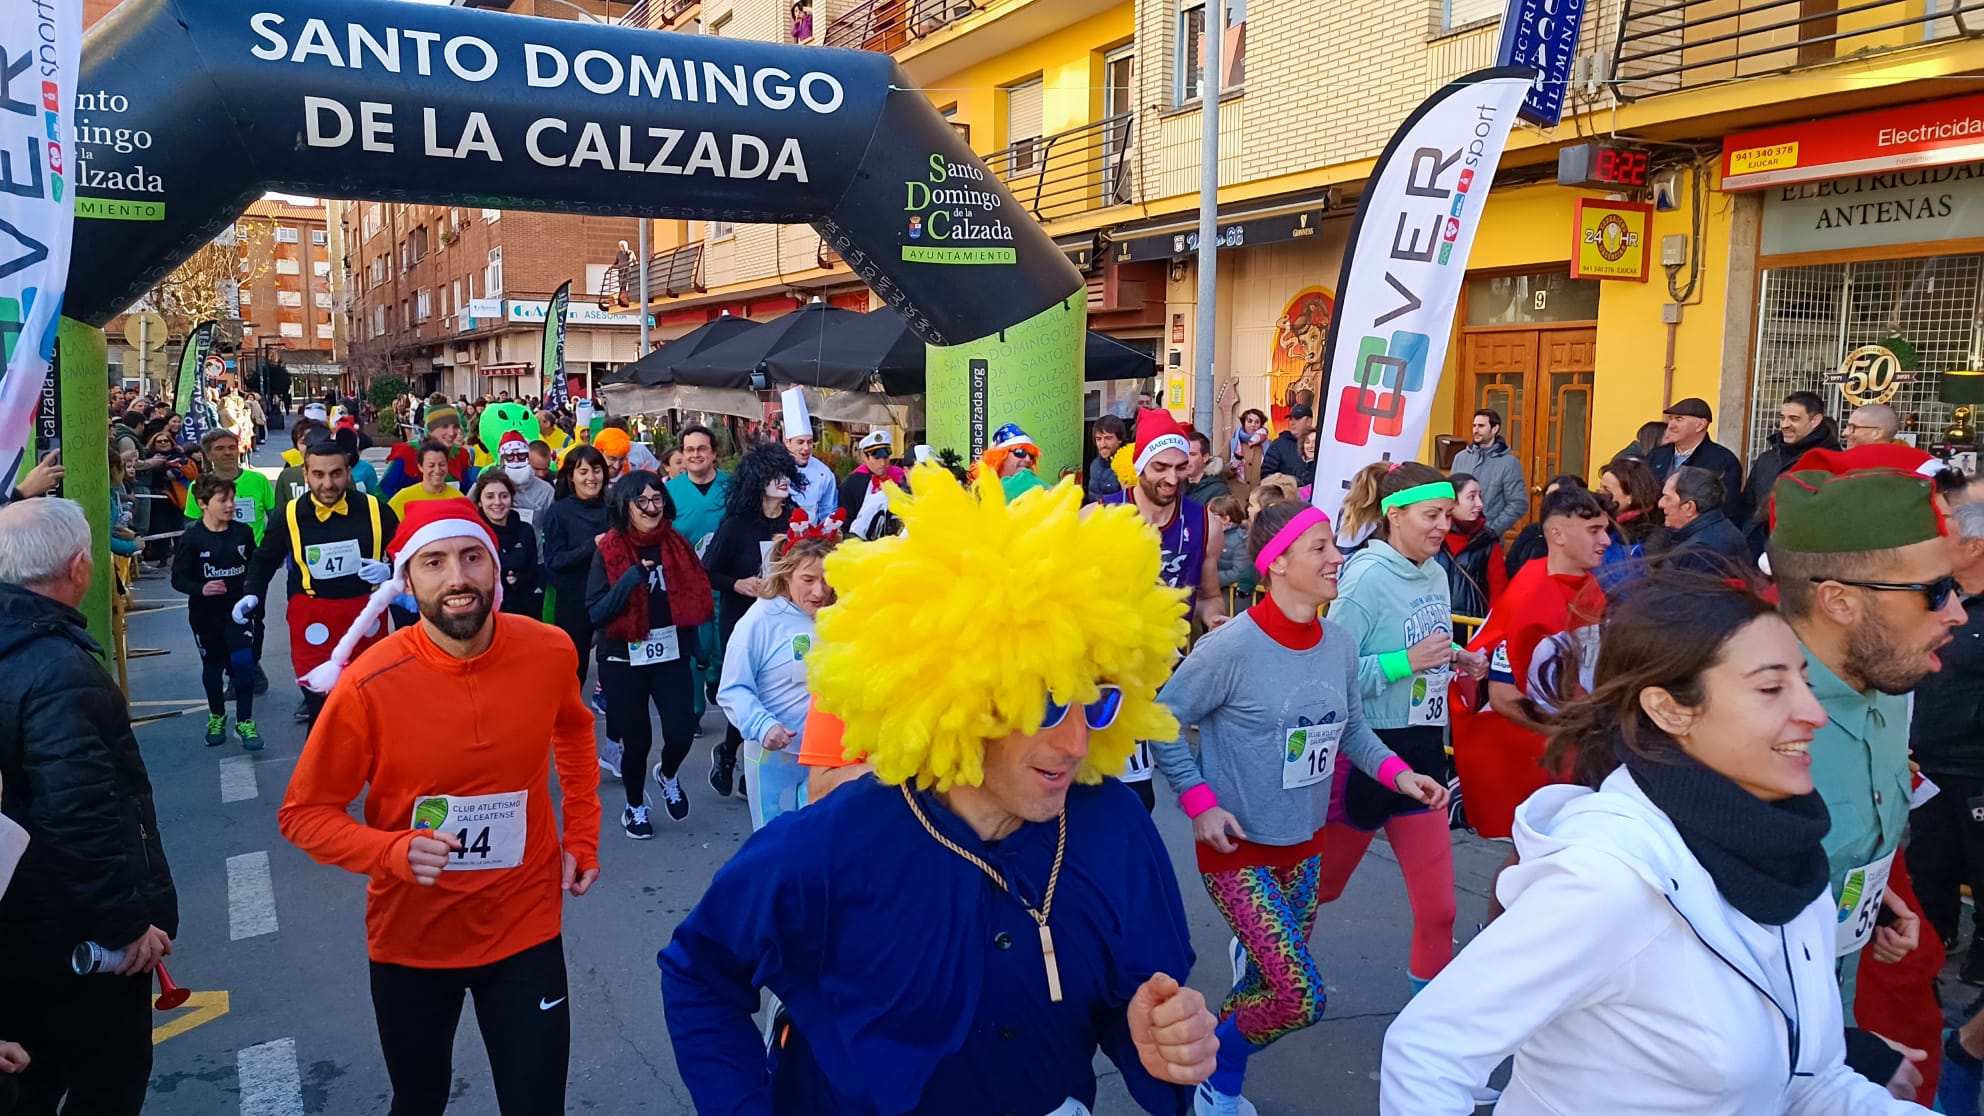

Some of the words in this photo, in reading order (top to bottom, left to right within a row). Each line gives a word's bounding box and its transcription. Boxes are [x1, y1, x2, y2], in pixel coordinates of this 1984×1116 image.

[250, 12, 498, 82] SANTO
[524, 43, 844, 114] DOMINGO
[75, 90, 129, 113] nto
[304, 95, 394, 153] DE
[423, 107, 503, 162] LA
[525, 117, 809, 183] CALZADA
[1468, 103, 1498, 168] sport
[1878, 116, 1984, 147] Electricida
[929, 153, 984, 183] Santo
[1595, 150, 1647, 185] 13:22
[1736, 151, 1752, 161] 941
[1755, 149, 1773, 159] 340
[1776, 146, 1793, 155] 378
[1748, 158, 1779, 169] EJUCAR
[75, 161, 164, 193] lzada
[1781, 162, 1984, 201] ELECTRICIDA
[904, 181, 1001, 211] Domingo
[927, 210, 1014, 240] Calzada
[953, 208, 964, 218] de
[965, 208, 973, 218] la
[1815, 194, 1953, 230] ANTENAS
[1226, 225, 1244, 247] 66
[1584, 229, 1603, 244] 24
[1619, 231, 1639, 247] HR
[909, 249, 1011, 261] AYUNTAMIENTO
[1536, 292, 1545, 308] 9
[1844, 354, 1897, 395] 50
[325, 556, 344, 573] 47
[646, 643, 664, 659] 69
[1426, 696, 1443, 720] 38
[1308, 747, 1328, 776] 16
[453, 805, 475, 813] CLUB
[477, 800, 521, 811] ATLETISMO
[457, 811, 516, 822] CALCEATENSE
[449, 826, 491, 859] 44
